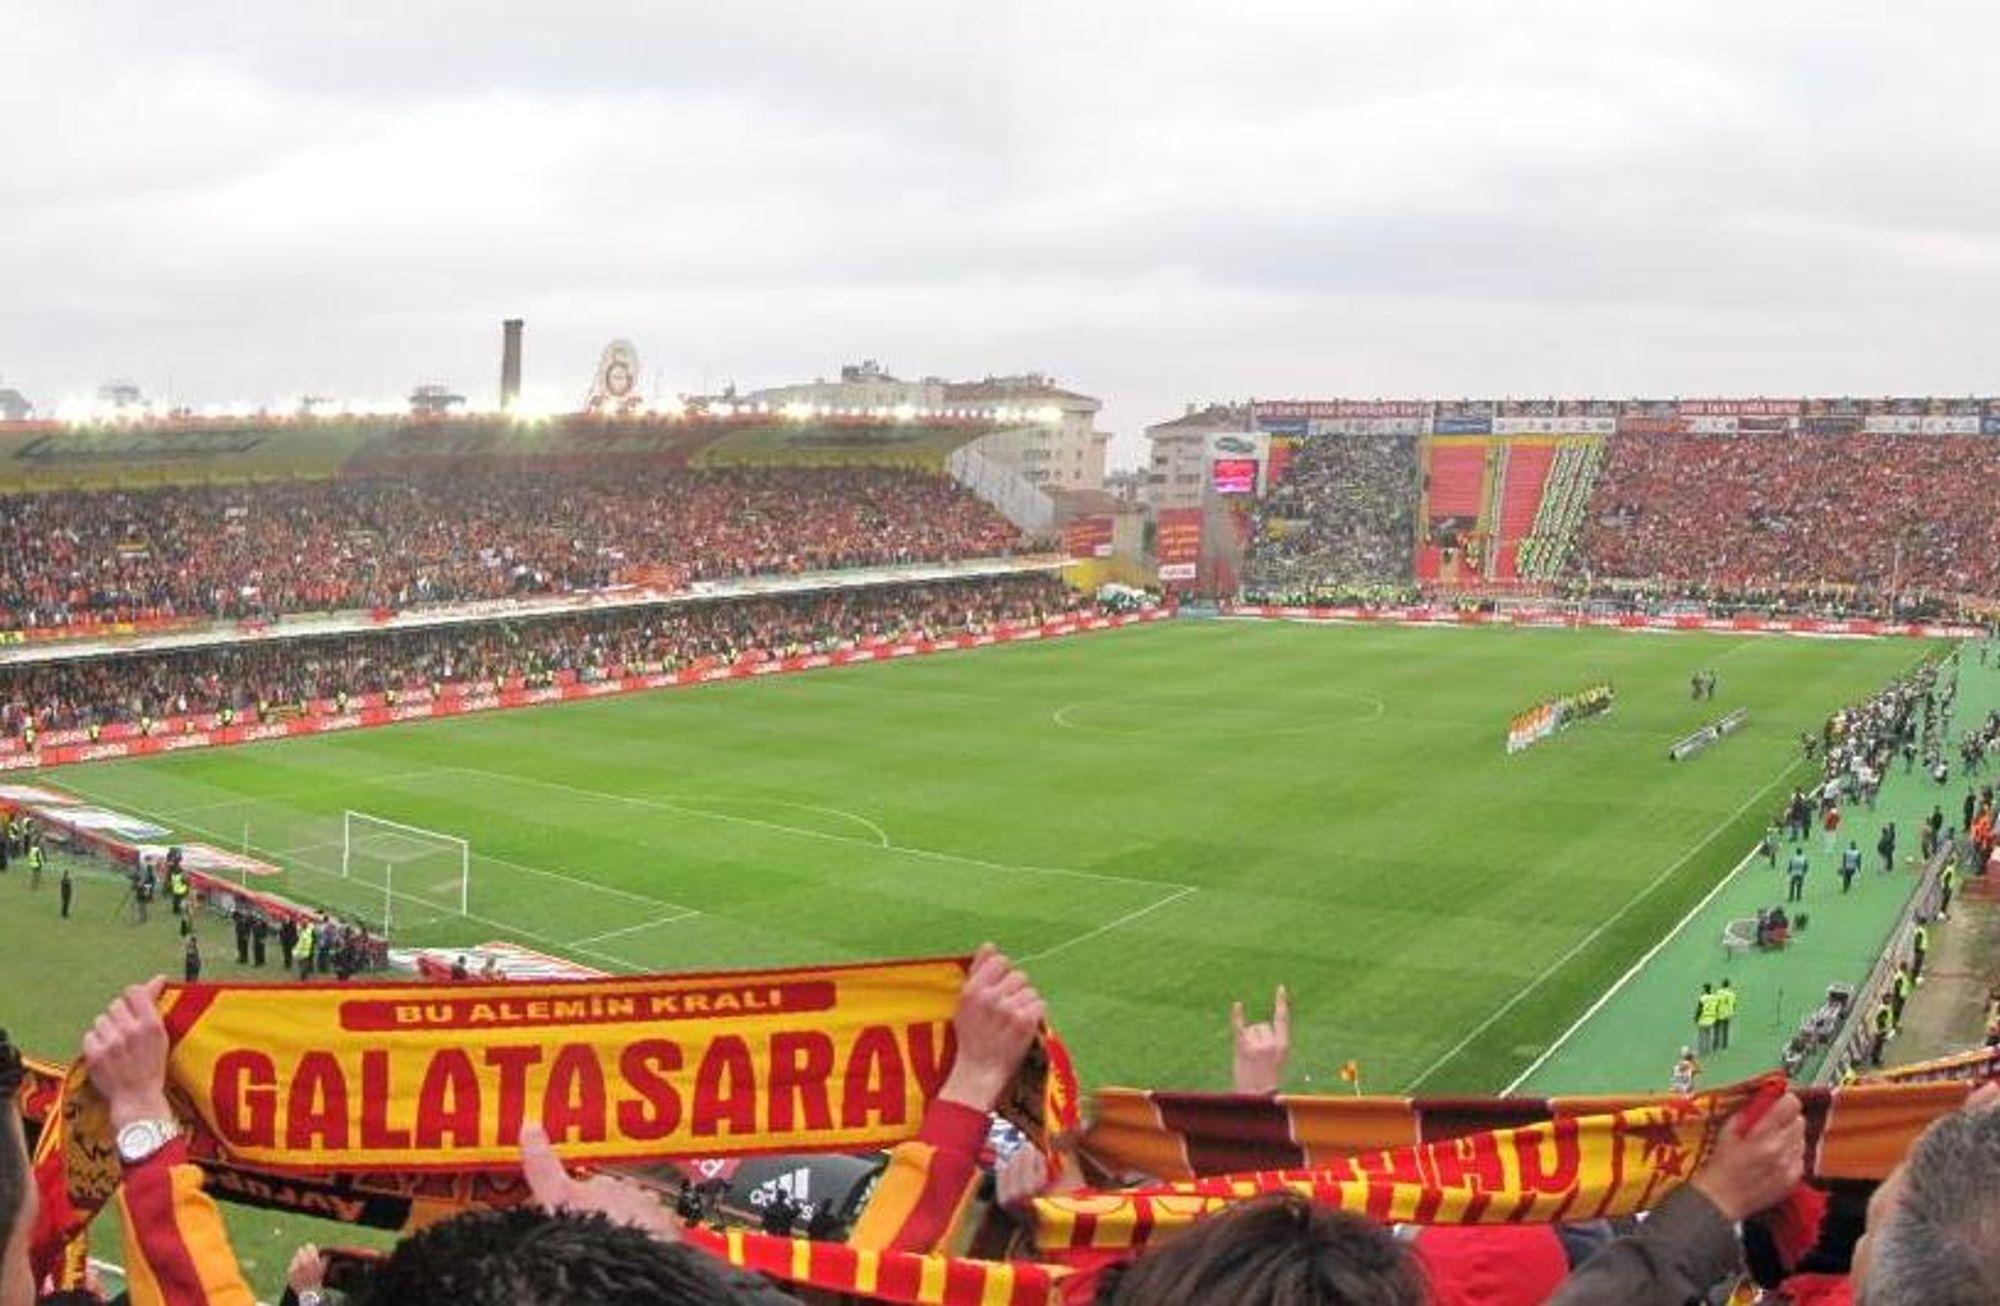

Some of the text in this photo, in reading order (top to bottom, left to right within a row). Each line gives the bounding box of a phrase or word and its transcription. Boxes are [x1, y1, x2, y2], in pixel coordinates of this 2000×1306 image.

[395, 1004, 453, 1024] BU
[650, 988, 782, 1014] KRALI
[211, 1019, 958, 1151] GALATASARAY
